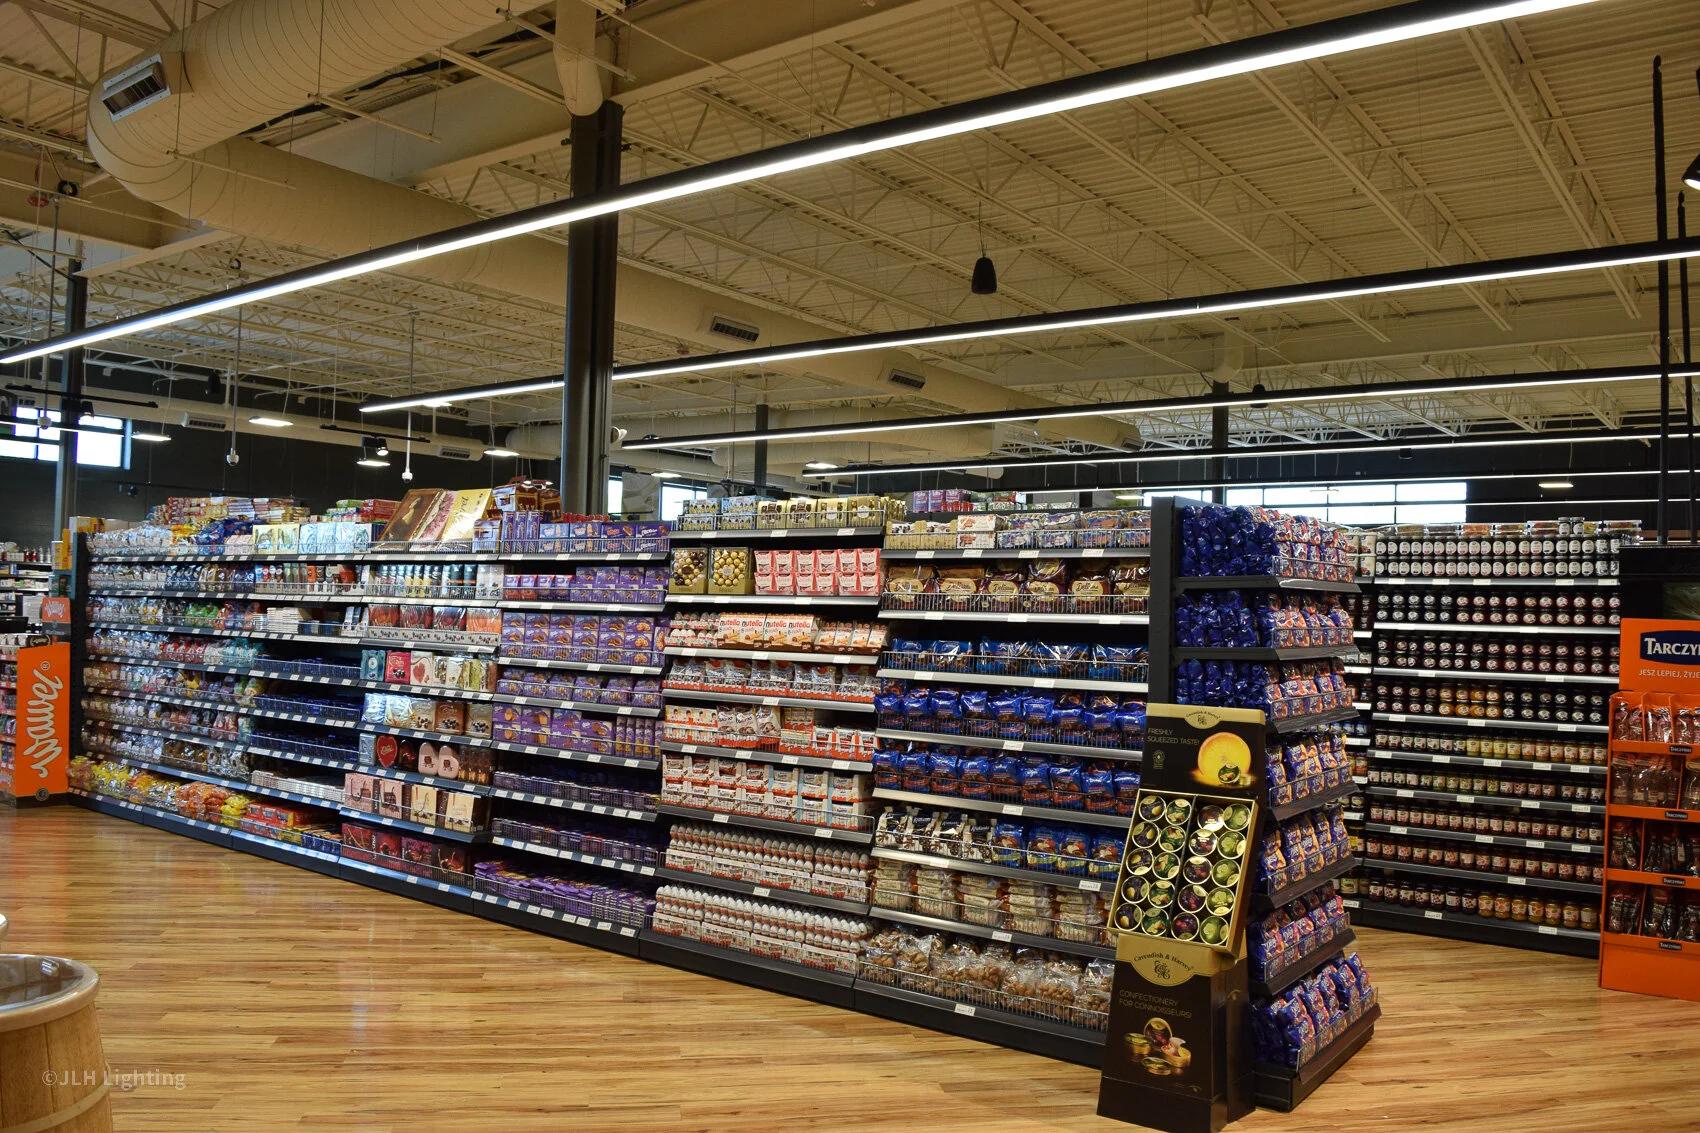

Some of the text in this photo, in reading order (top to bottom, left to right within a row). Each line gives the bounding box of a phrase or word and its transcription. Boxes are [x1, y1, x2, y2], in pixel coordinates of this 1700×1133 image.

[719, 619, 741, 627] nutella
[765, 620, 787, 629] nutella
[788, 621, 811, 629] nutella
[1147, 727, 1174, 735] FRESHLY
[1147, 736, 1179, 744] SQUEEZED
[1134, 952, 1164, 962] Cavendish
[1171, 956, 1192, 972] Harvey
[1119, 990, 1178, 1006] CONFECTIONERY
[1119, 999, 1133, 1007] FOR
